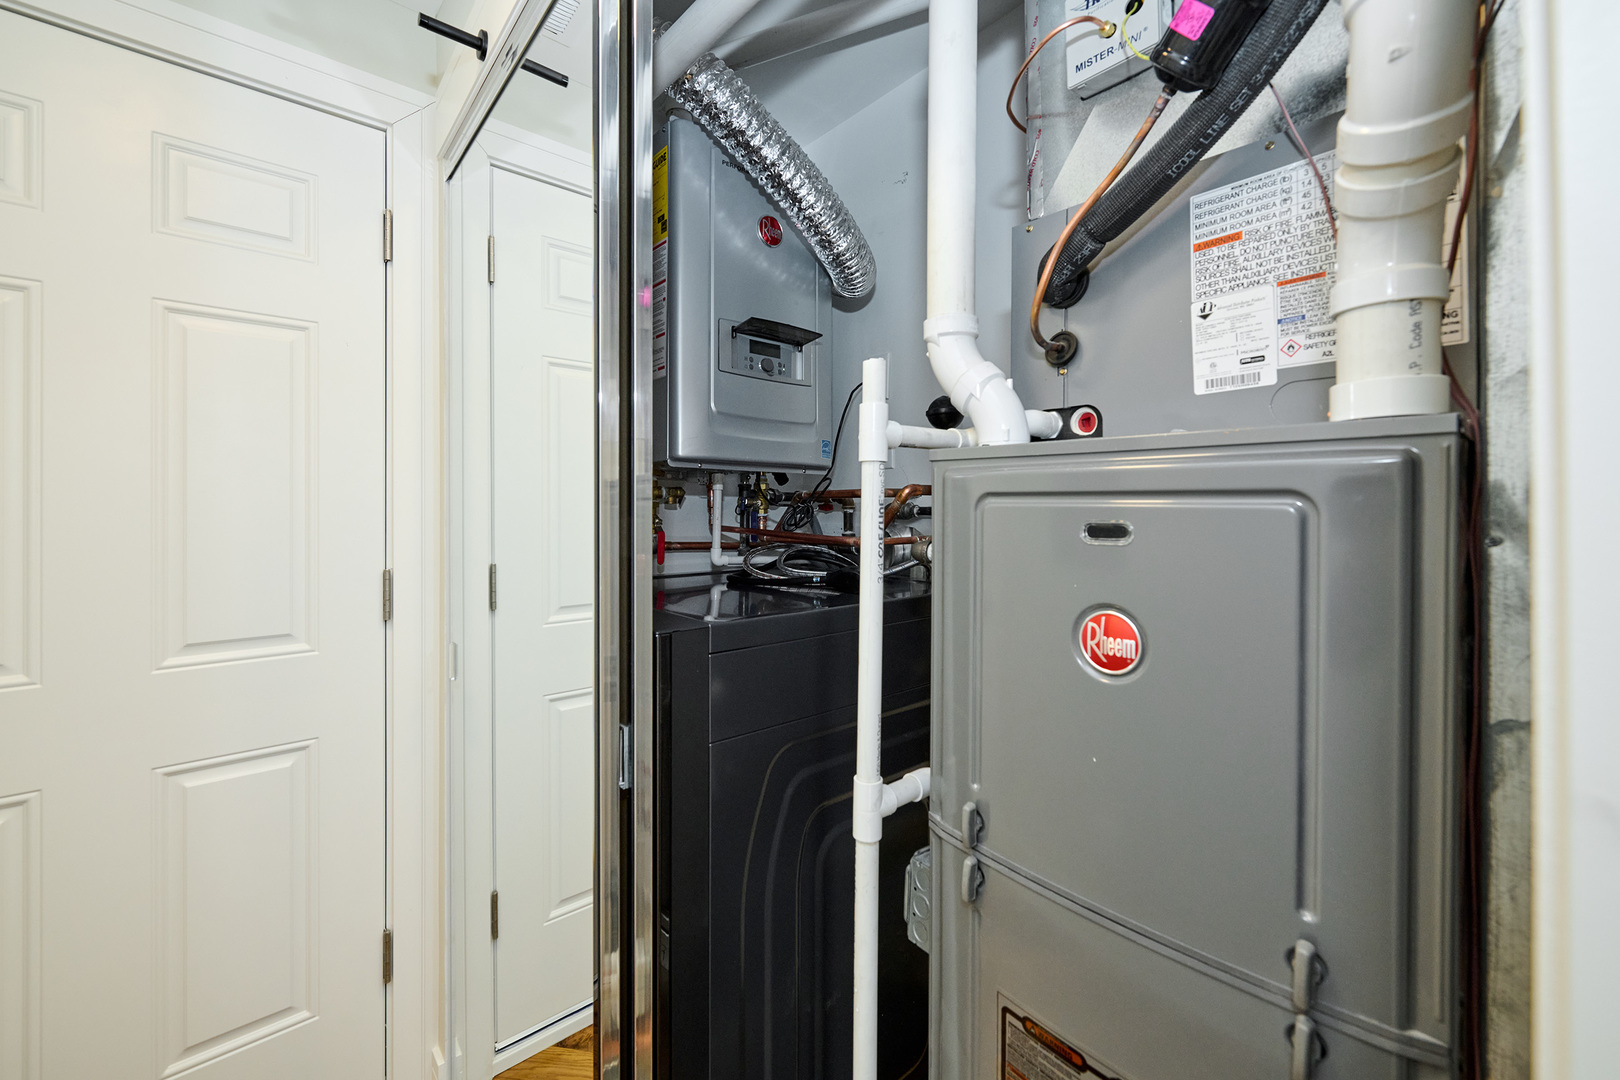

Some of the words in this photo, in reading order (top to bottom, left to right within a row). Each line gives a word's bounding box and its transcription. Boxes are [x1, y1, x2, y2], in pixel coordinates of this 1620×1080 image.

[1200, 114, 1229, 144] LINE
[1229, 85, 1254, 112] SET
[1194, 189, 1244, 210] REFRIGERANT
[1246, 177, 1278, 194] CHARGE
[1303, 168, 1309, 176] 3
[1321, 162, 1327, 170] 5
[1194, 200, 1244, 221] REFRIGERANT
[1246, 188, 1278, 205] CHARGE
[1302, 179, 1312, 188] 1.4
[1195, 216, 1228, 230] MINIMUM
[1230, 208, 1254, 221] ROOM
[1255, 201, 1277, 213] AREA
[1301, 190, 1312, 198] 45
[1195, 226, 1228, 241] MINIMUM
[1230, 219, 1254, 231] ROOM
[1255, 211, 1277, 224] AREA
[762, 218, 781, 240] Rheem
[1202, 232, 1240, 248] WARNING
[1244, 226, 1262, 238] RISK
[1263, 223, 1273, 233] OF
[1217, 245, 1226, 253] TO
[1228, 241, 1237, 251] BE
[1239, 232, 1276, 248] REPAIRED
[1277, 226, 1299, 238] ONLY
[1300, 221, 1311, 232] BY
[1240, 246, 1251, 256] DO
[1253, 240, 1269, 252] NOT
[1271, 230, 1314, 247] PUNCTURE
[1195, 265, 1211, 276] RISK
[1212, 262, 1222, 271] OF
[1286, 237, 1322, 252] DEVICES
[1195, 269, 1230, 284] SOURCES
[1231, 263, 1254, 275] SHALL
[1256, 257, 1272, 269] NOT
[1273, 254, 1285, 264] BE
[1286, 244, 1331, 261] INSTALLED
[1195, 279, 1220, 292] OTHER
[1221, 275, 1241, 286] THAN
[1282, 256, 1319, 271] DEVICES
[1195, 286, 1227, 299] SPECIFIC
[1273, 271, 1288, 281] SEE
[1303, 340, 1329, 351] SAFETY
[1408, 321, 1422, 349] Code
[1087, 616, 1136, 662] Rheem
[1038, 1030, 1073, 1060] WARNING
